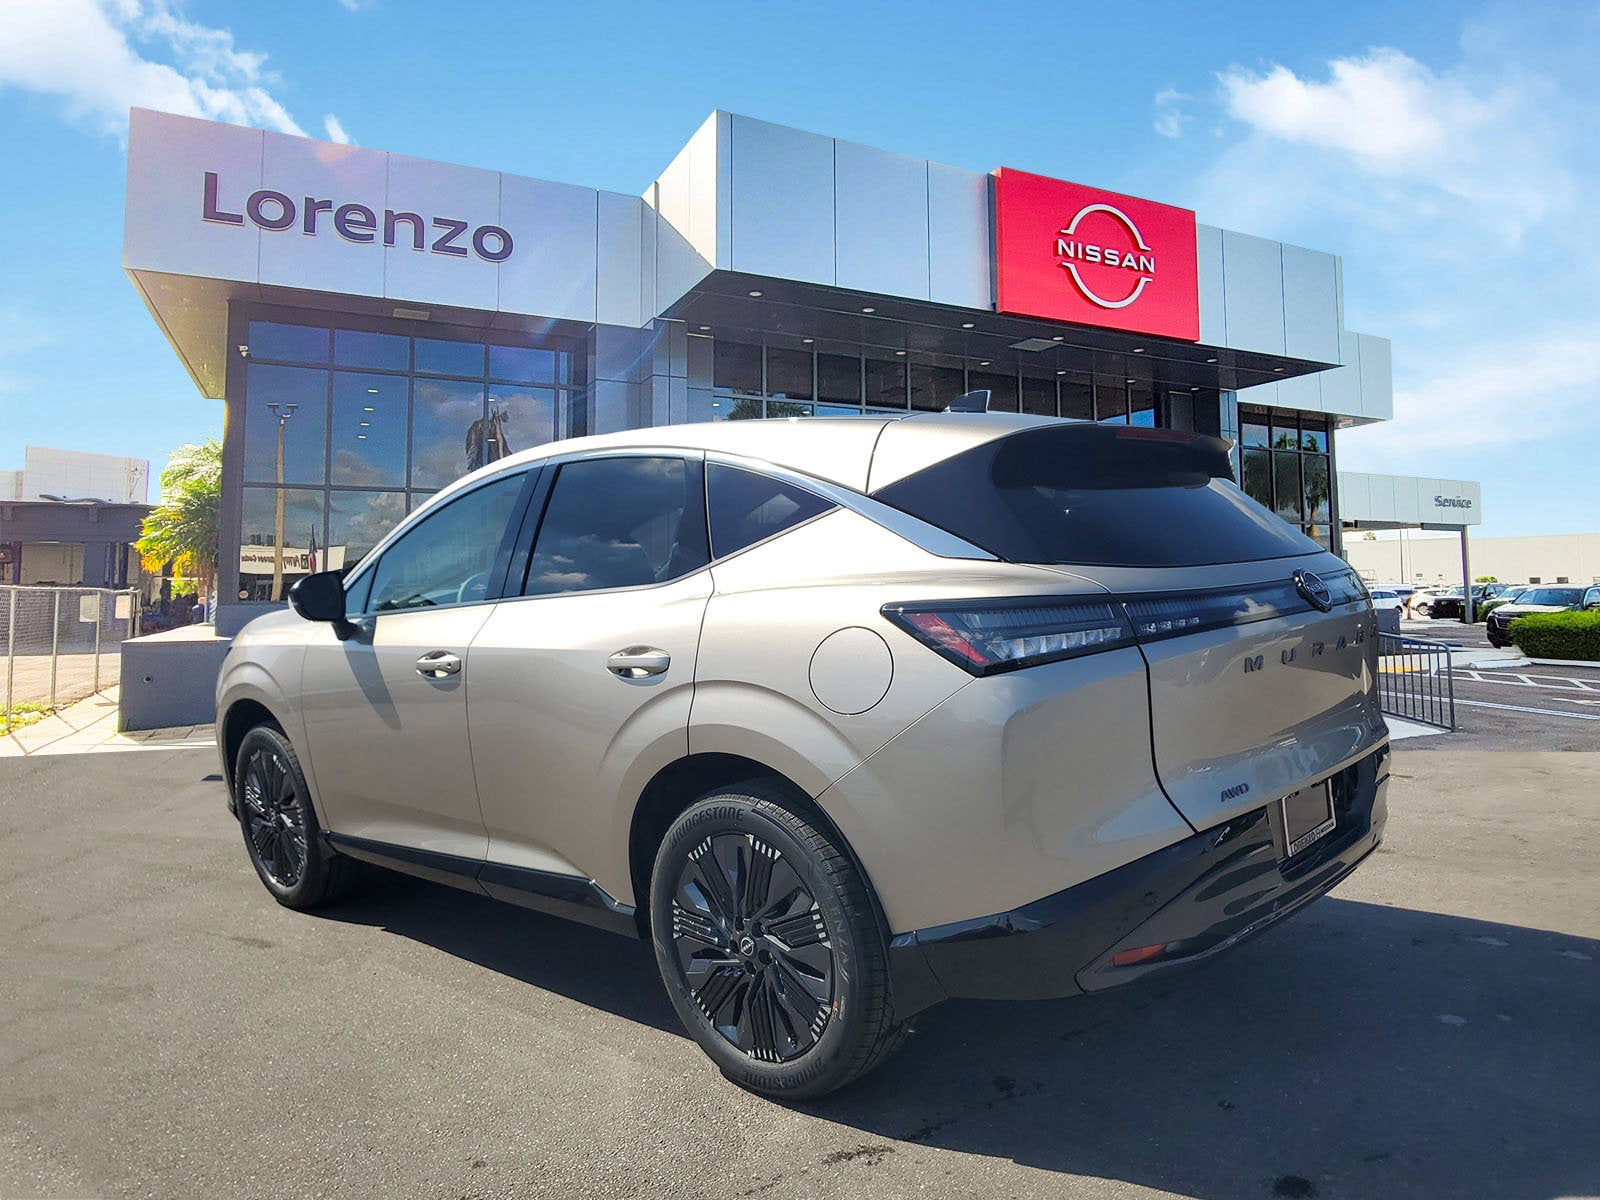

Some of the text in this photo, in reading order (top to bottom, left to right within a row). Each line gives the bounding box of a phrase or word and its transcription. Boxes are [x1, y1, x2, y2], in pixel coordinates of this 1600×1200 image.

[203, 171, 514, 262] Lorenzo
[1058, 238, 1155, 273] NISSAN
[1434, 495, 1472, 508] Service
[1221, 783, 1249, 802] AWD
[668, 806, 745, 848] BRIDGESTONE
